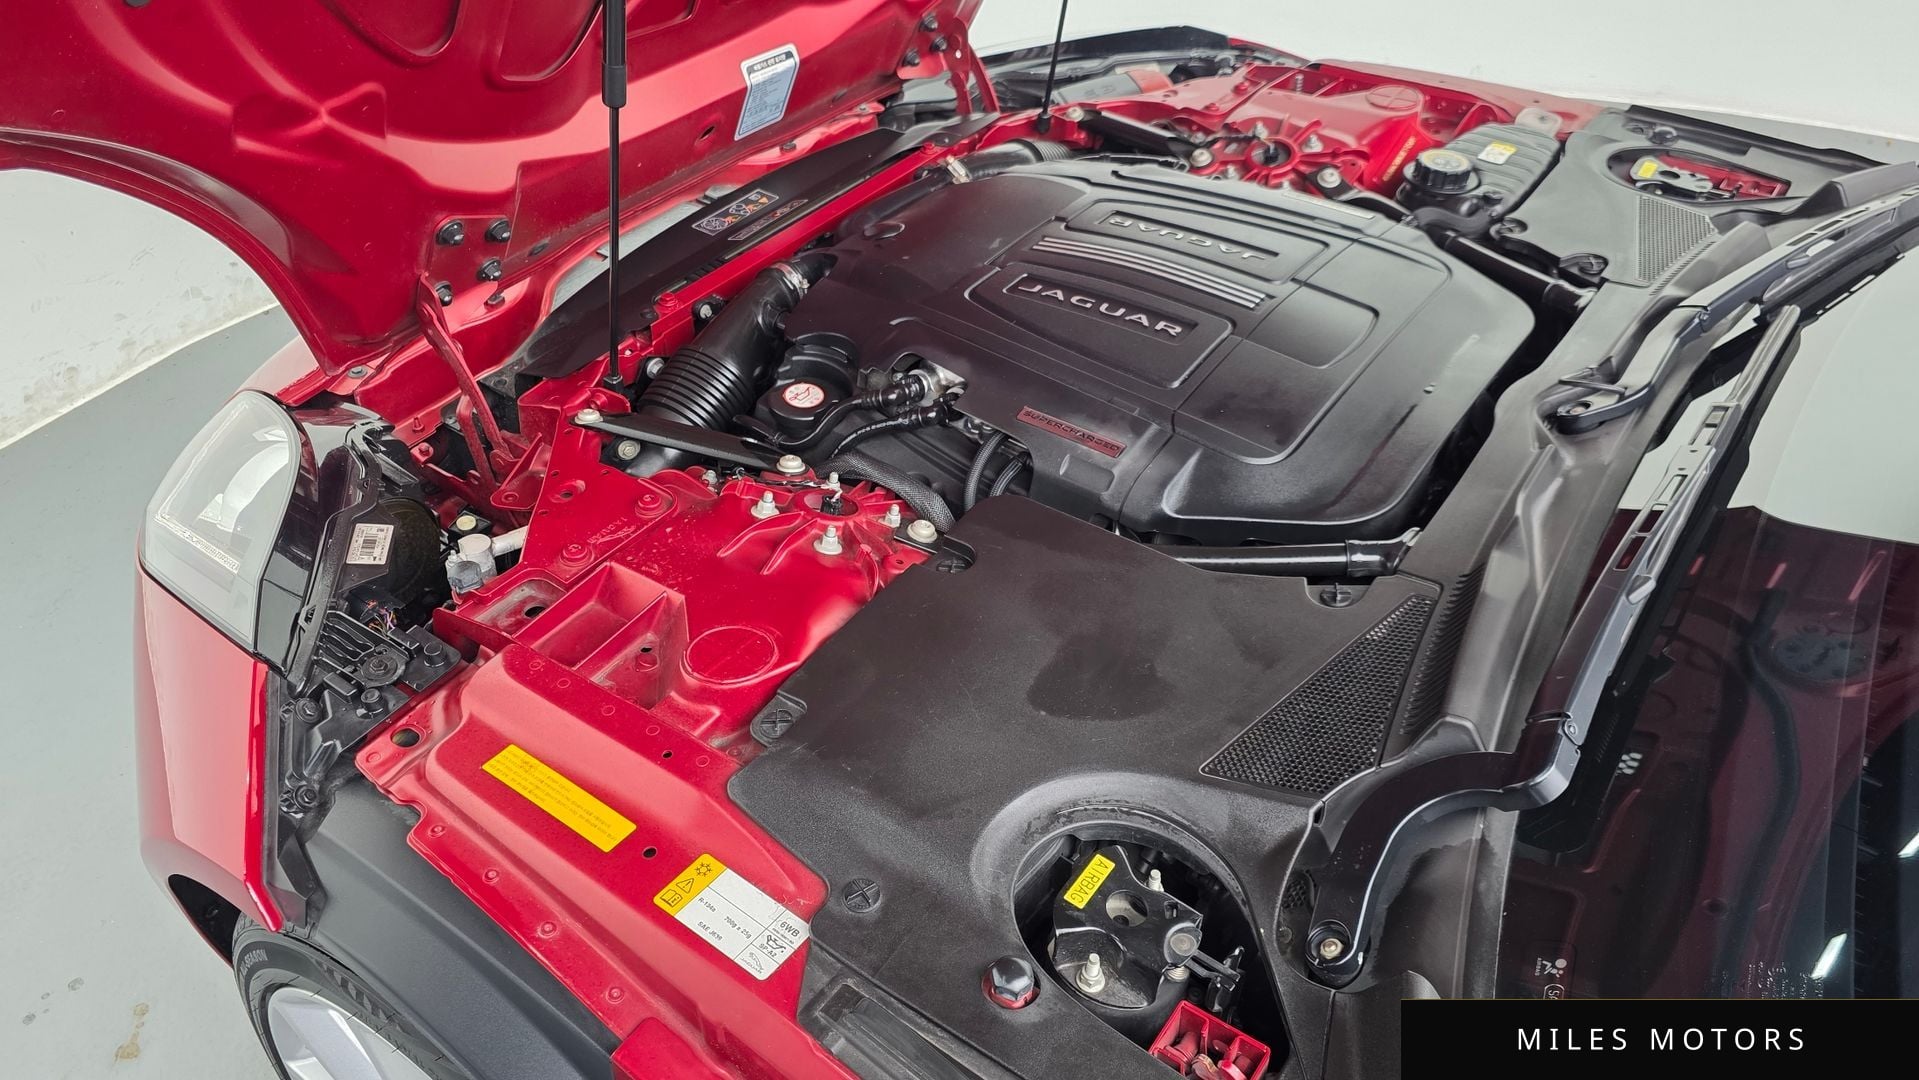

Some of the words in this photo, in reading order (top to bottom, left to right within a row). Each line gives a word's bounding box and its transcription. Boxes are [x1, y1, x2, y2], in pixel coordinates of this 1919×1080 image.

[1109, 217, 1265, 261] JAGUAR
[1018, 284, 1183, 337] JAGUAR
[1023, 408, 1121, 451] SUPERCHARGED
[1070, 858, 1109, 903] AIRBAG
[779, 921, 801, 938] 6WB
